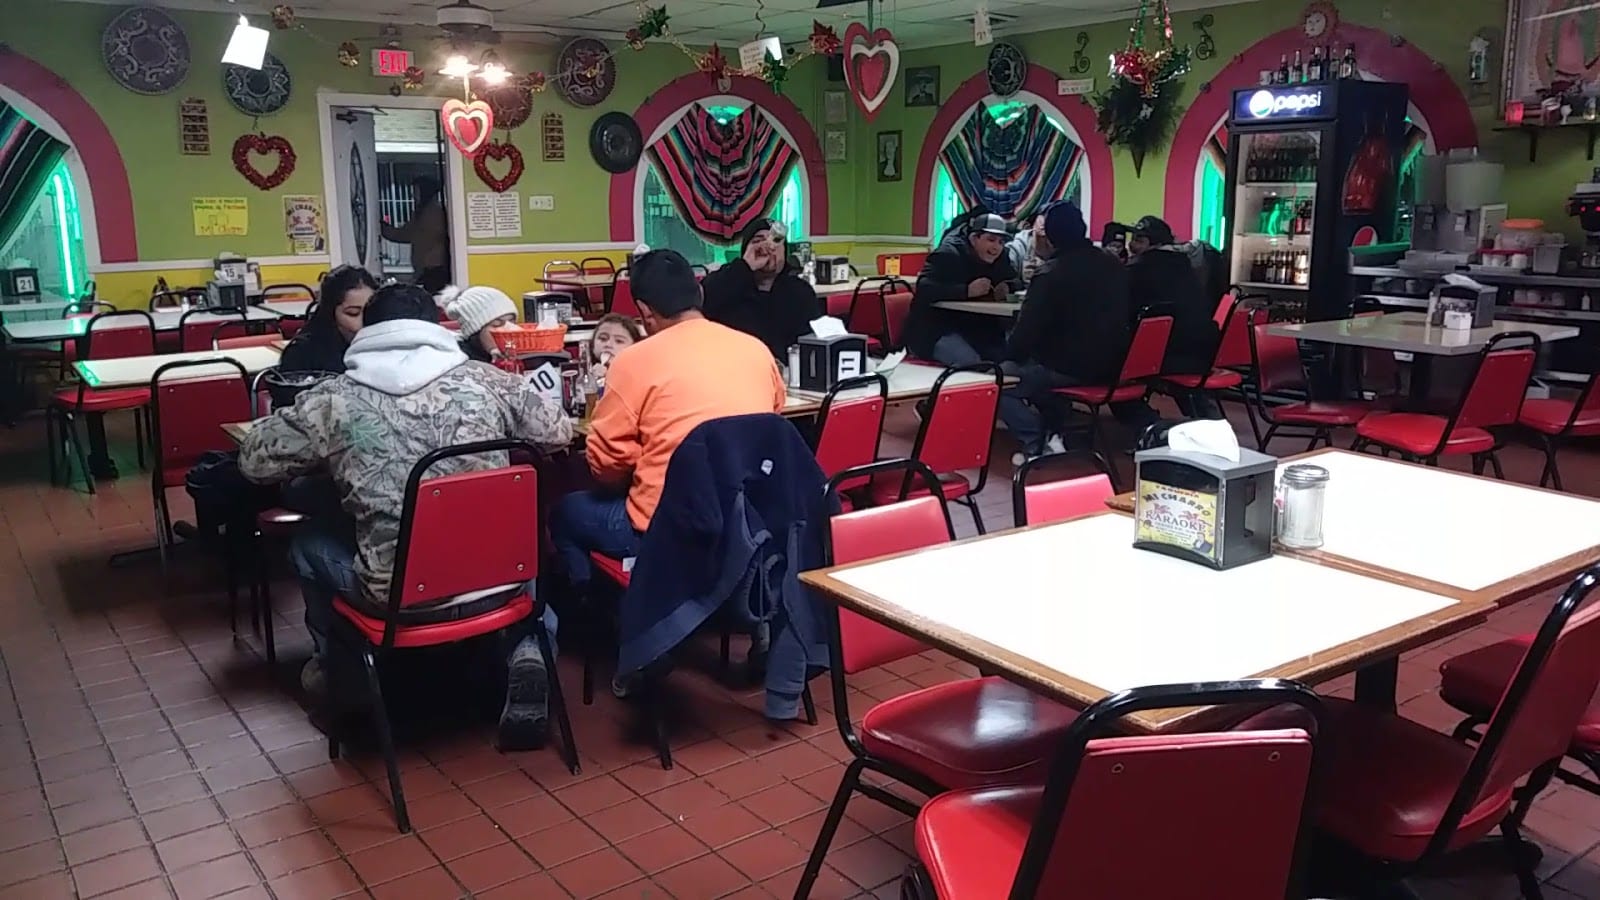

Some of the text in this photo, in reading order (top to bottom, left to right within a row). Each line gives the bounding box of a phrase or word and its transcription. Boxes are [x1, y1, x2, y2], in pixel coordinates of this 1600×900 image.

[380, 50, 408, 74] EXIT
[1273, 90, 1322, 114] pepsi
[20, 279, 32, 290] 21
[841, 357, 855, 374] 11
[529, 370, 555, 392] 10
[1142, 493, 1211, 516] MI CHARRO
[1145, 509, 1207, 532] KARAOKE
